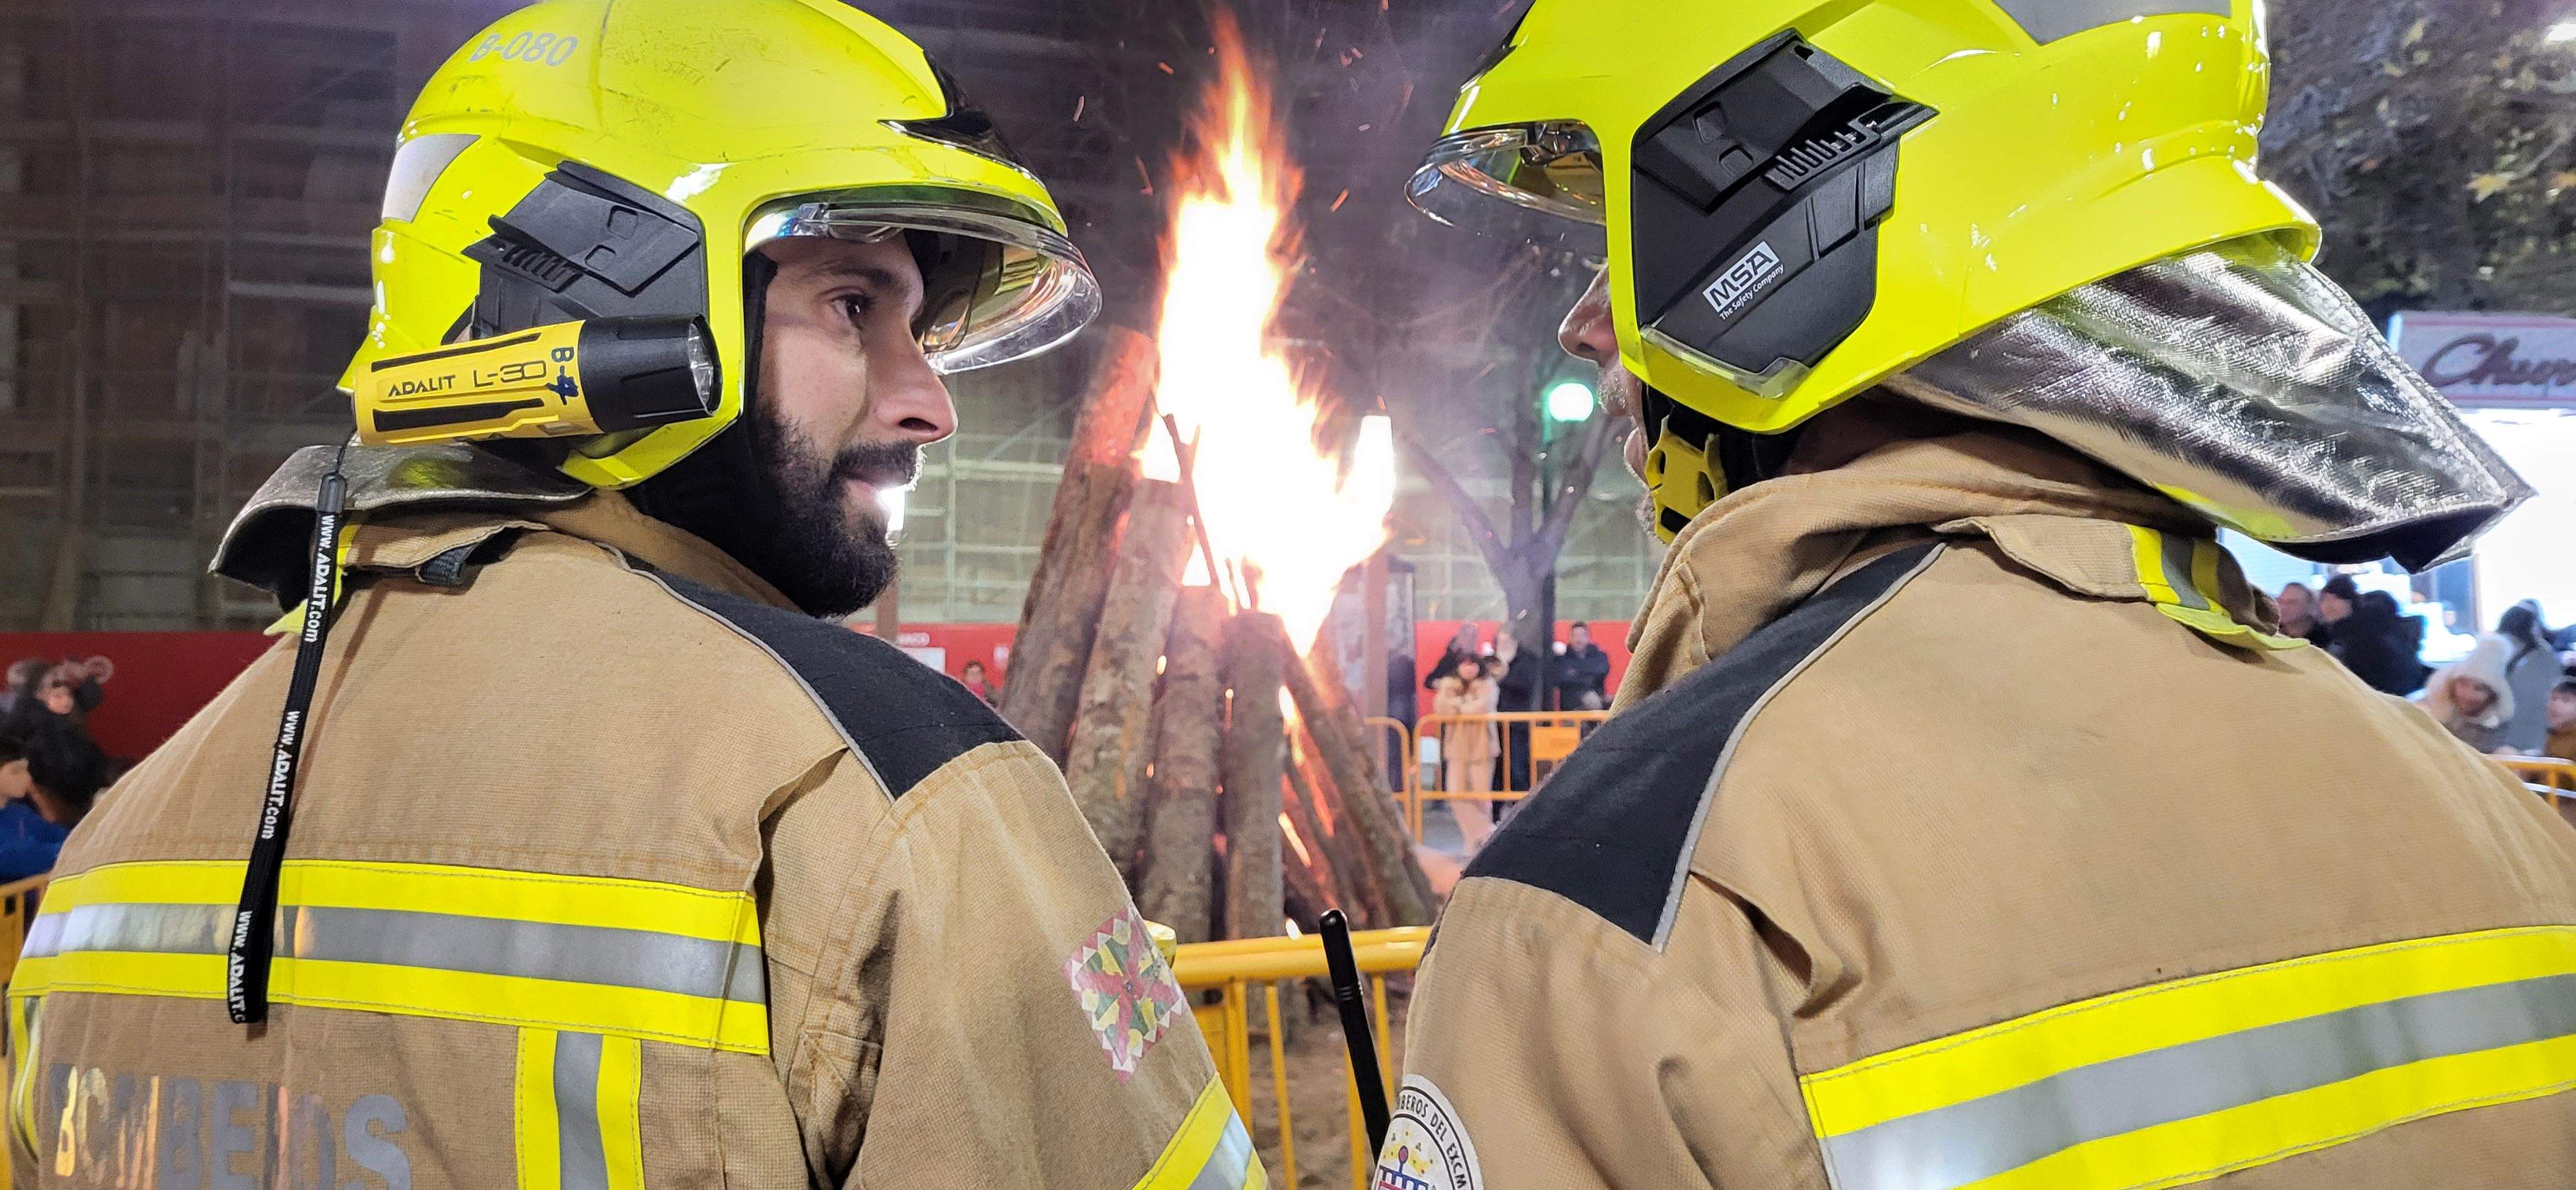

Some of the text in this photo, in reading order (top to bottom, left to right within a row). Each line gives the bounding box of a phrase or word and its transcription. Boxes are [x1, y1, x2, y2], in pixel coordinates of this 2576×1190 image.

[468, 32, 578, 68] B-080
[1709, 250, 1774, 308] MSA
[1719, 263, 1785, 321] The Safety Company
[388, 360, 546, 397] ADALIT L-30
[304, 515, 335, 643] www.ADALIT.com
[261, 710, 301, 840] www.ADALIT.com
[1396, 1094, 1468, 1190] BEROS DEL EXCM
